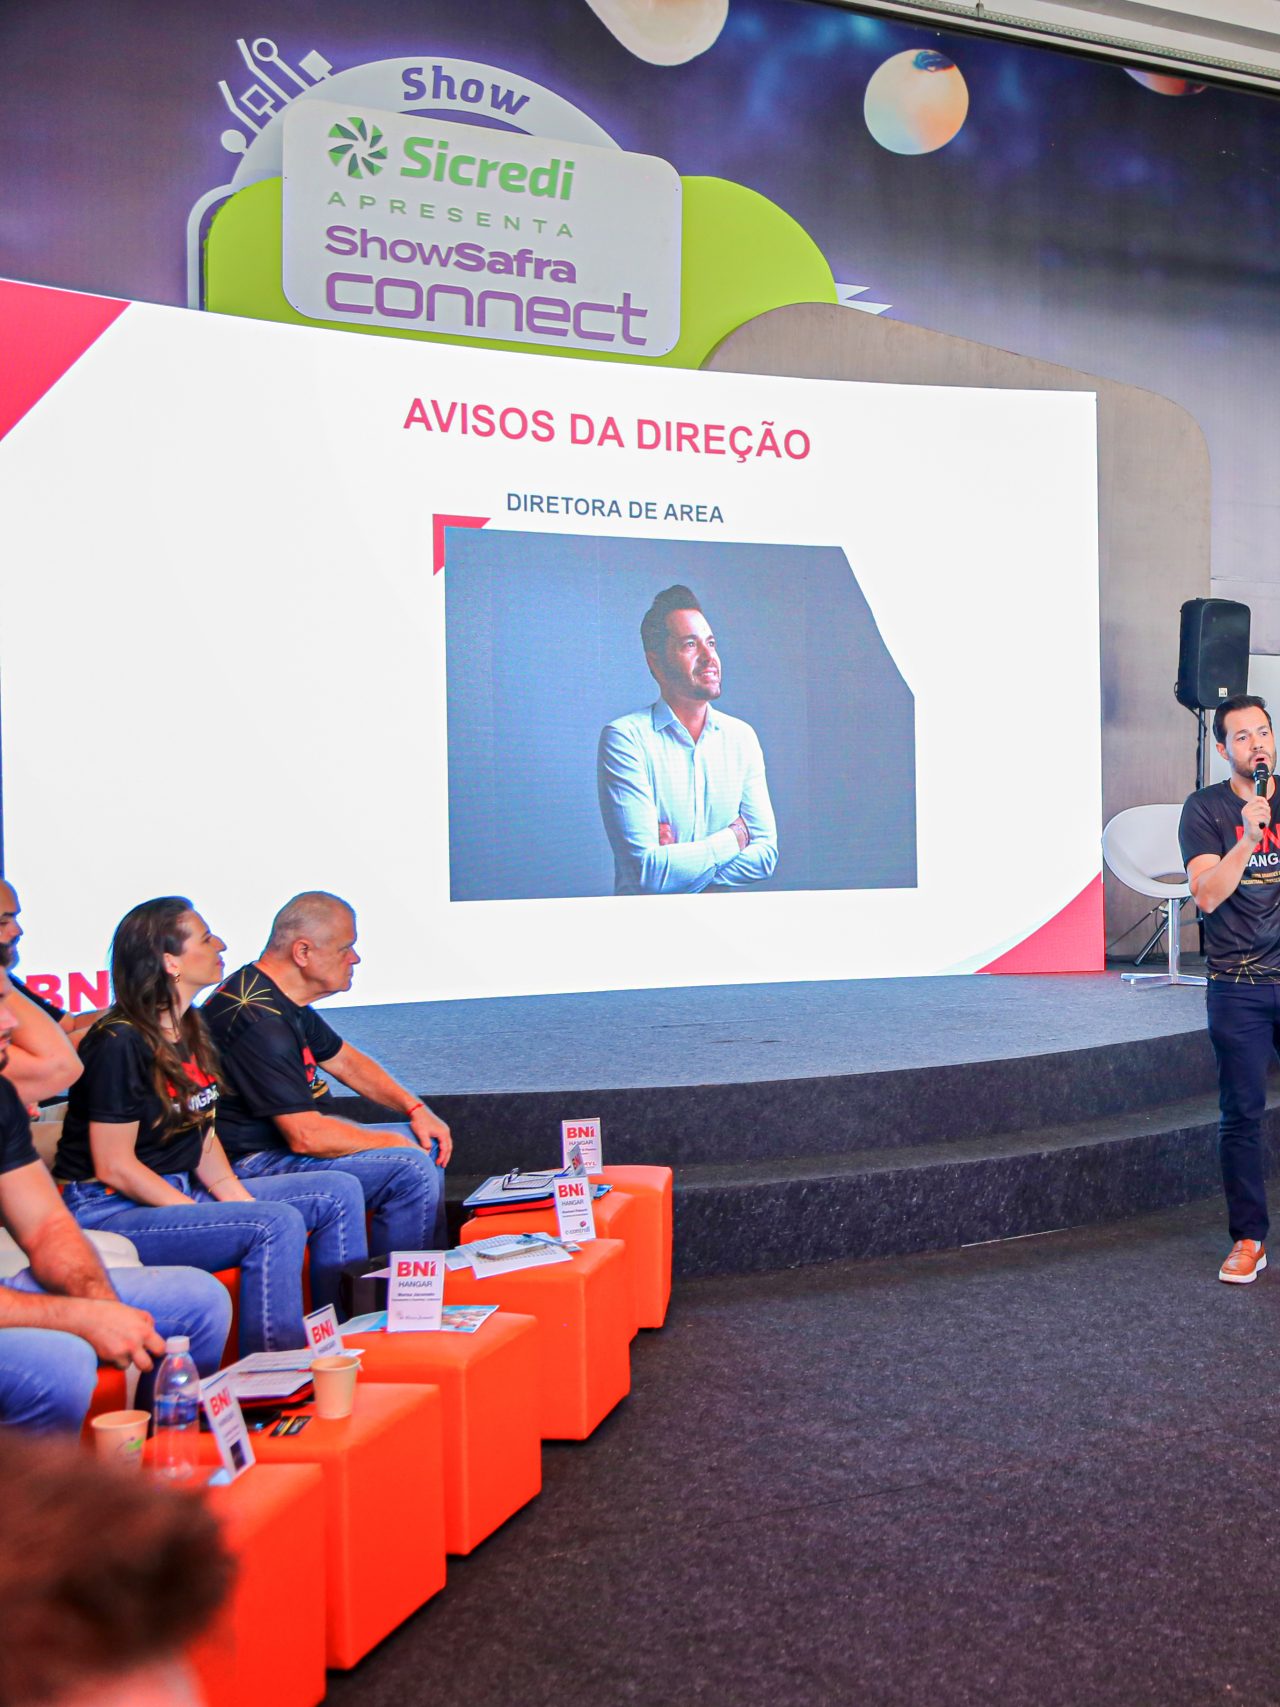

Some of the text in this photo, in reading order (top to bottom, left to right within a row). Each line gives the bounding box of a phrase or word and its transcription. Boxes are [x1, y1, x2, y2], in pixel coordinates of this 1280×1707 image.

[401, 65, 530, 116] Show
[400, 136, 576, 200] Sicredi
[327, 191, 574, 238] APRESENTA
[324, 225, 577, 284] ShowSafra
[325, 271, 649, 346] connect
[403, 397, 811, 464] AVISOS DA DIREÇÃO
[506, 492, 725, 524] DIRETORA DE AREA
[398, 1280, 433, 1289] HANGAR
